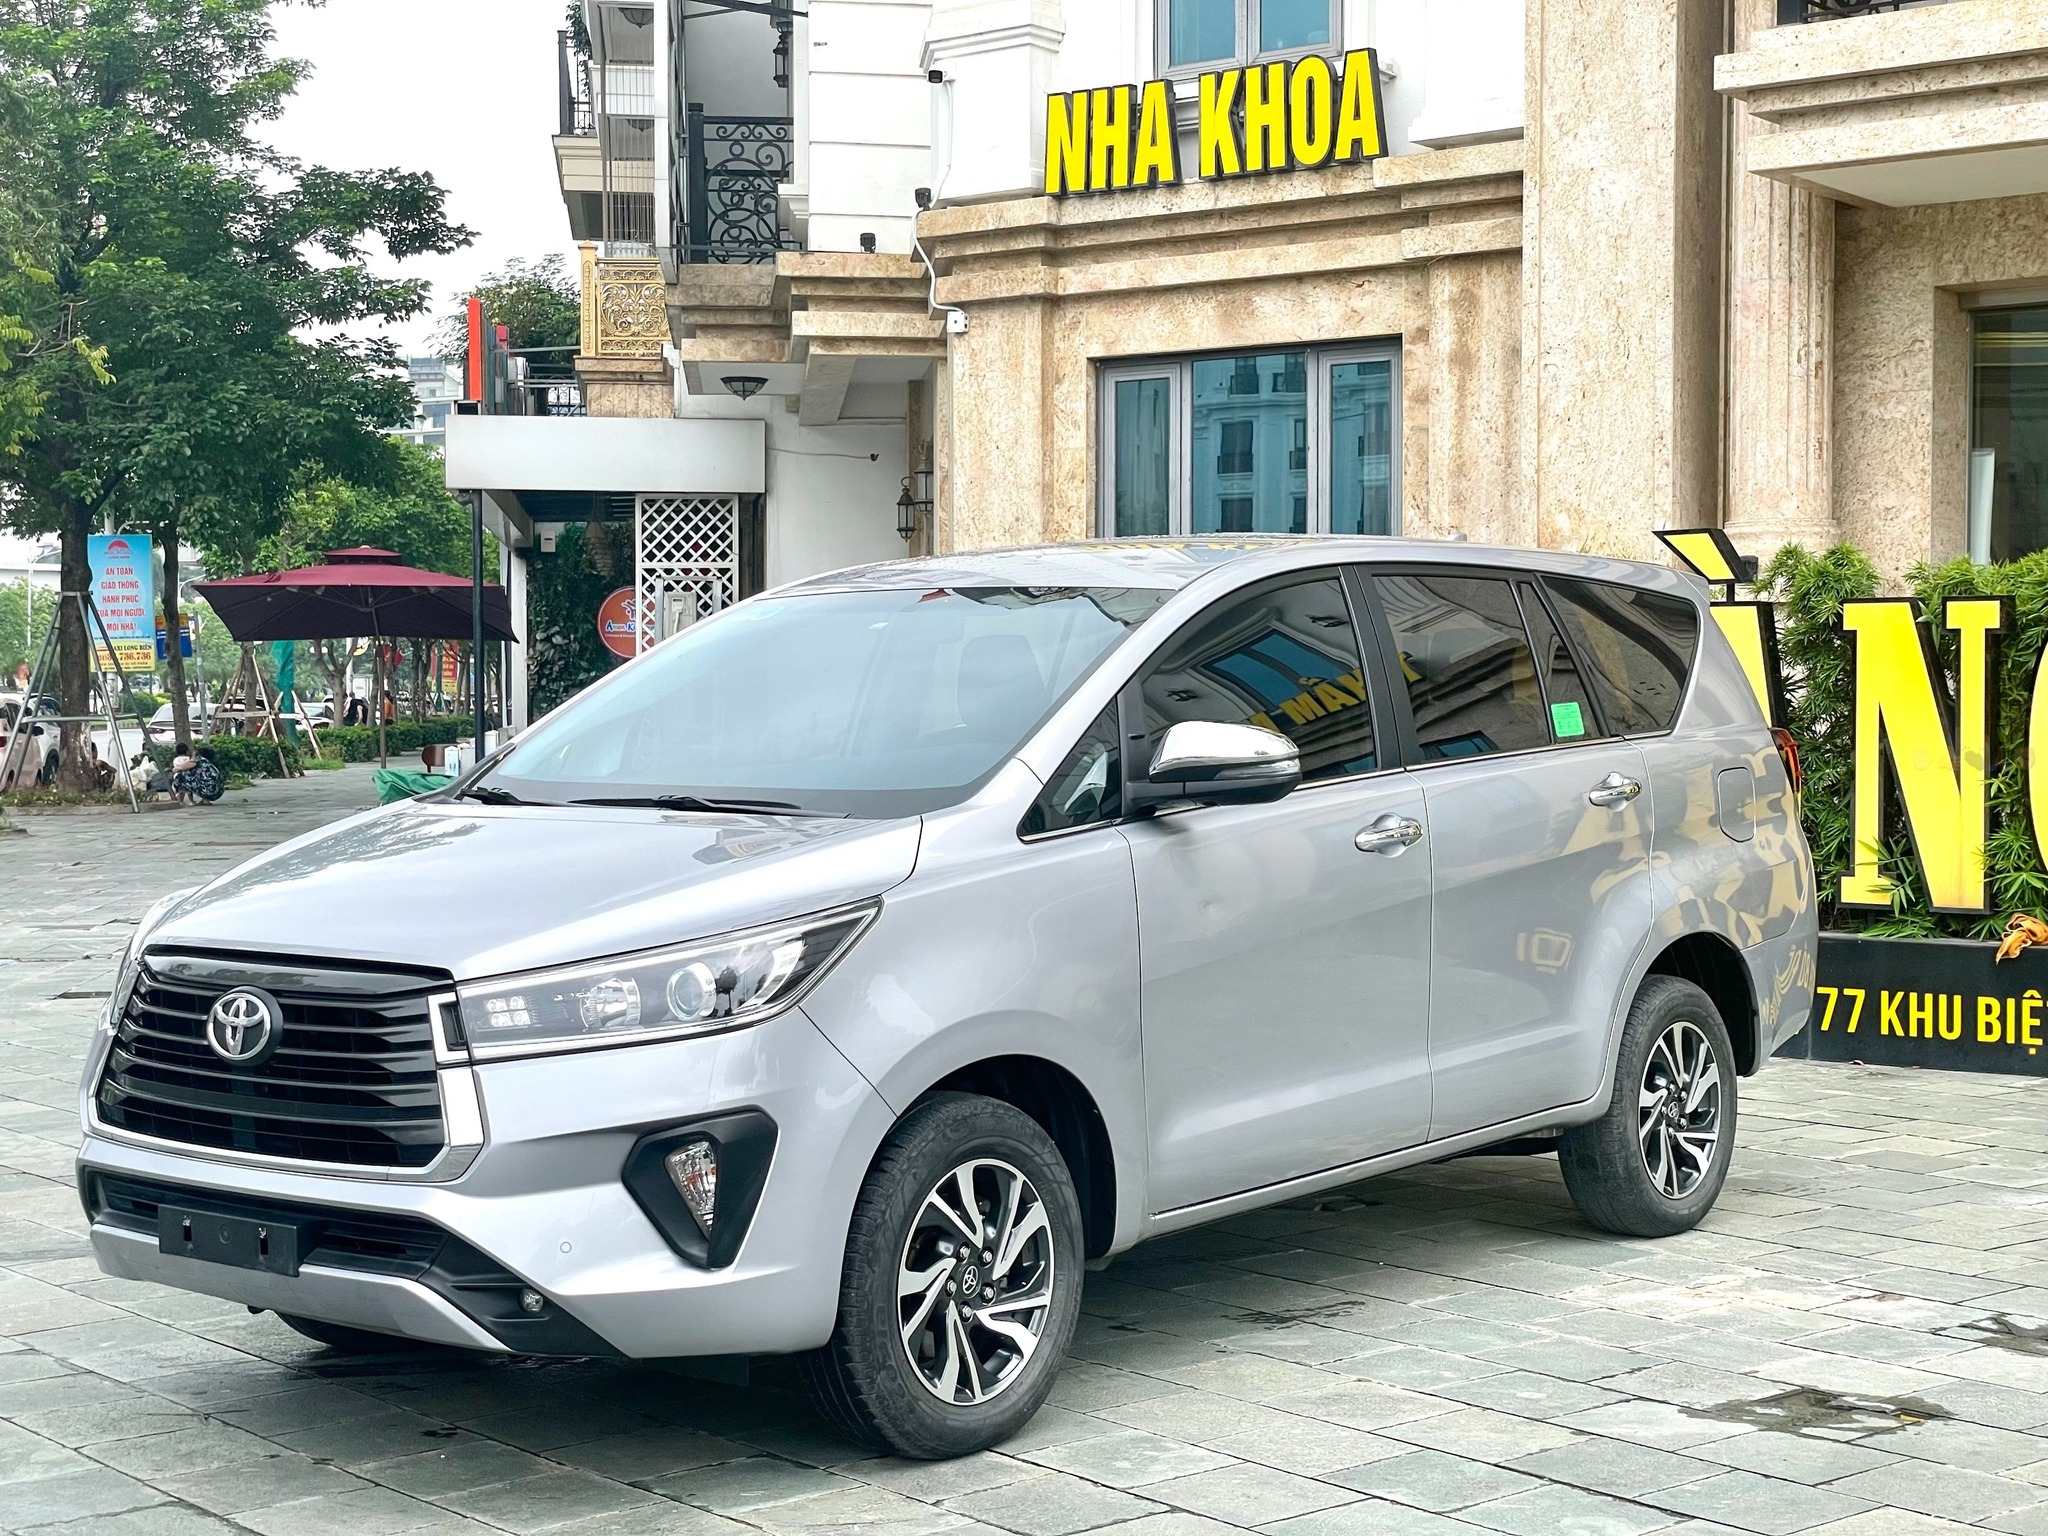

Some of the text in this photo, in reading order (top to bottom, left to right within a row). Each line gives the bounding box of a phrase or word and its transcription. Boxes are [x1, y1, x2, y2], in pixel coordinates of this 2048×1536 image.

[1044, 48, 1385, 196] NHA KHOA
[101, 581, 116, 590] GIAO
[106, 567, 115, 576] AN
[1880, 990, 1962, 1041] KHU
[1976, 989, 2048, 1055] BIỆ
